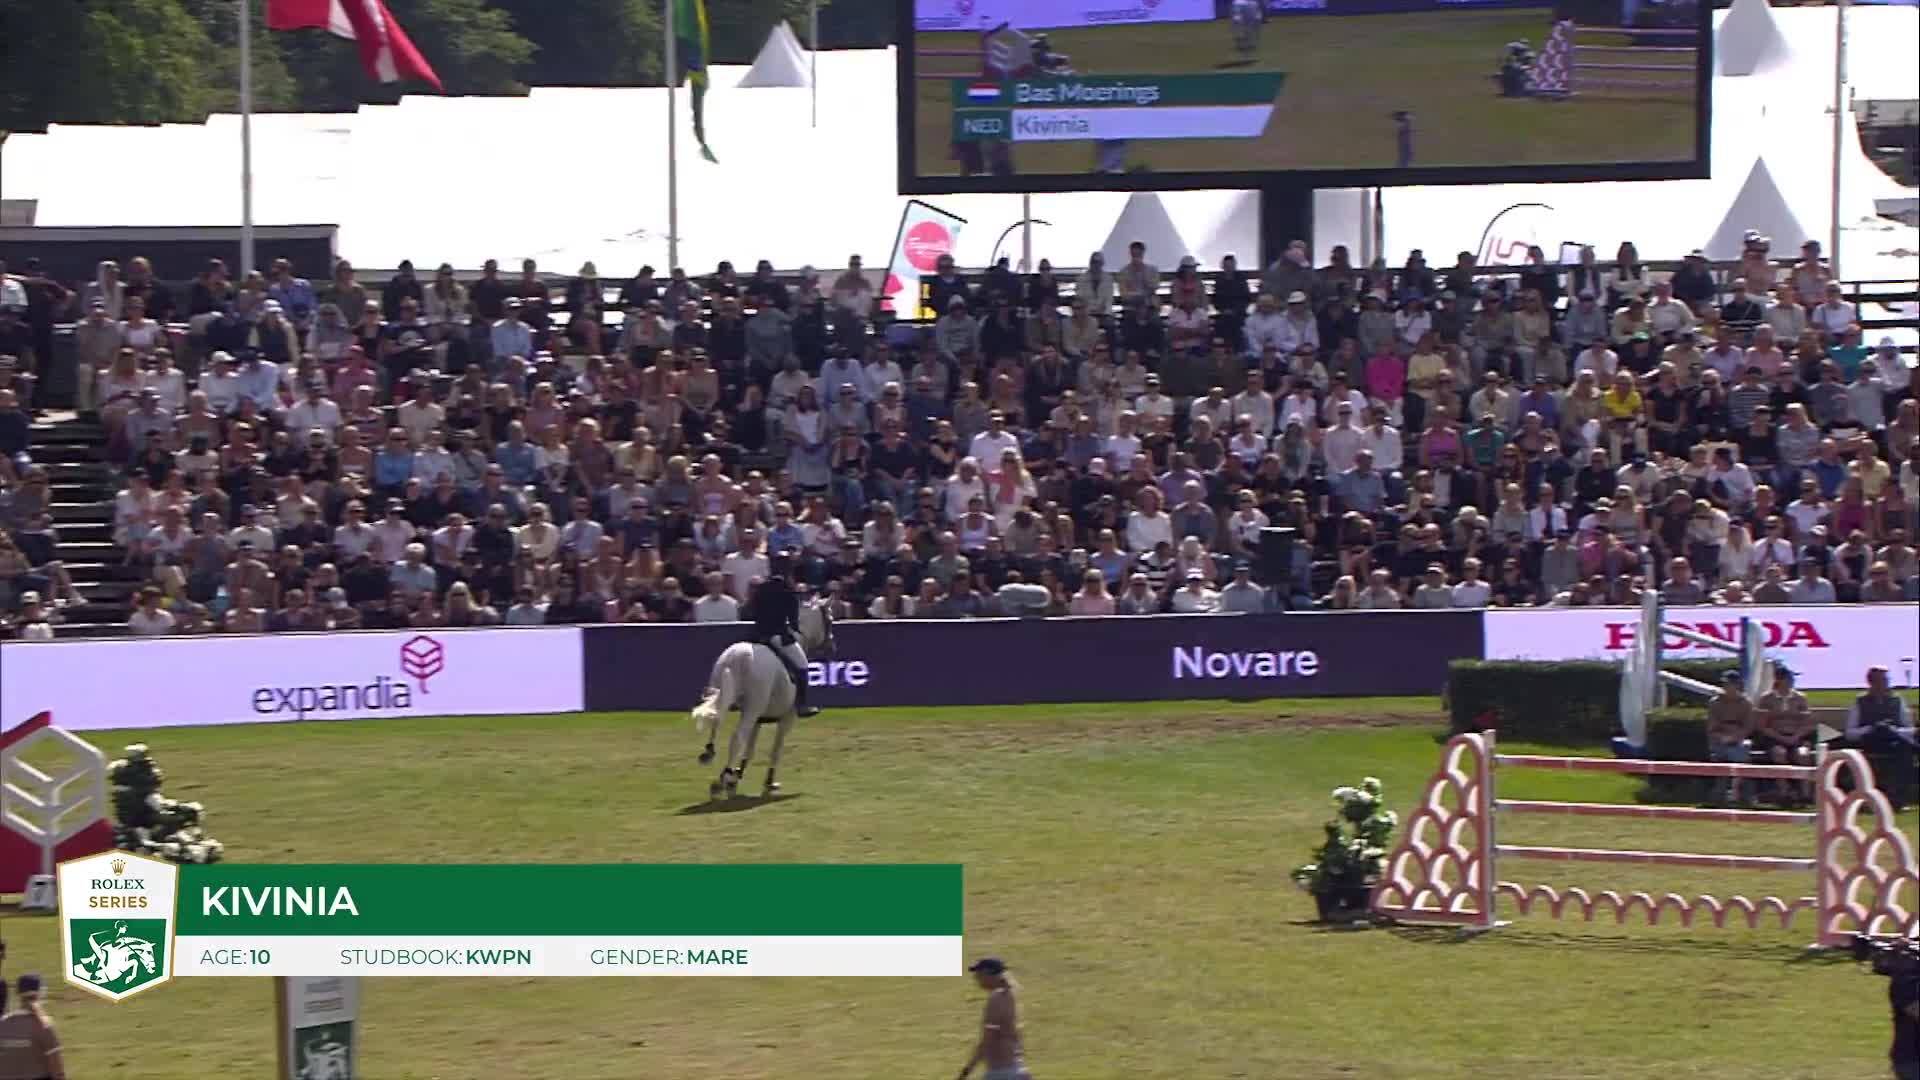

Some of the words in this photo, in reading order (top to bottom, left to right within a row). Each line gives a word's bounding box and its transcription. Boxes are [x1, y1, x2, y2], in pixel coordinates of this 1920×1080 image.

[1015, 83, 1055, 102] Bas
[963, 118, 1001, 133] NED
[1016, 115, 1090, 136] Kivinia
[807, 660, 869, 687] are
[1173, 646, 1319, 678] Novare
[253, 676, 412, 720] expandia
